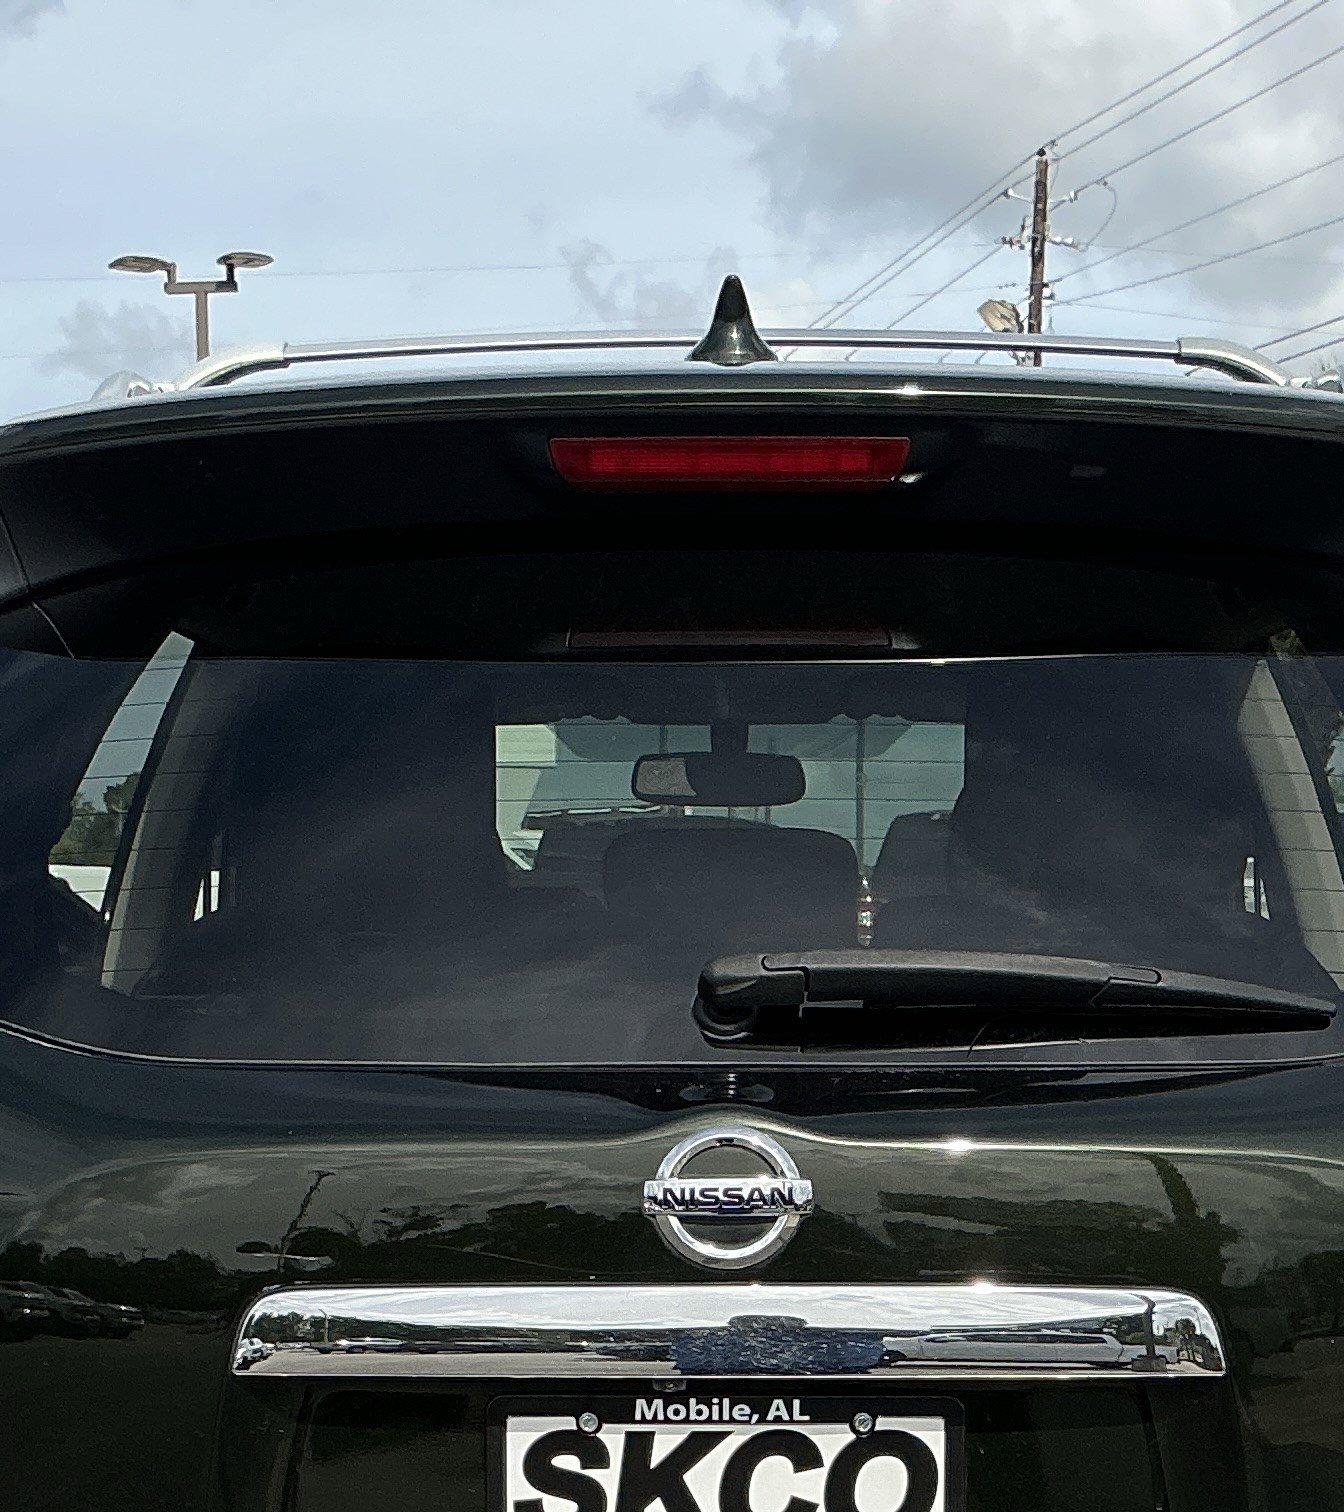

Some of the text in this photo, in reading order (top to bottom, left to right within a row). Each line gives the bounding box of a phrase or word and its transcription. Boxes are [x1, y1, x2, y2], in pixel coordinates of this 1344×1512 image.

[661, 1187, 794, 1209] NISSAN
[634, 1398, 811, 1423] Mobile, AL
